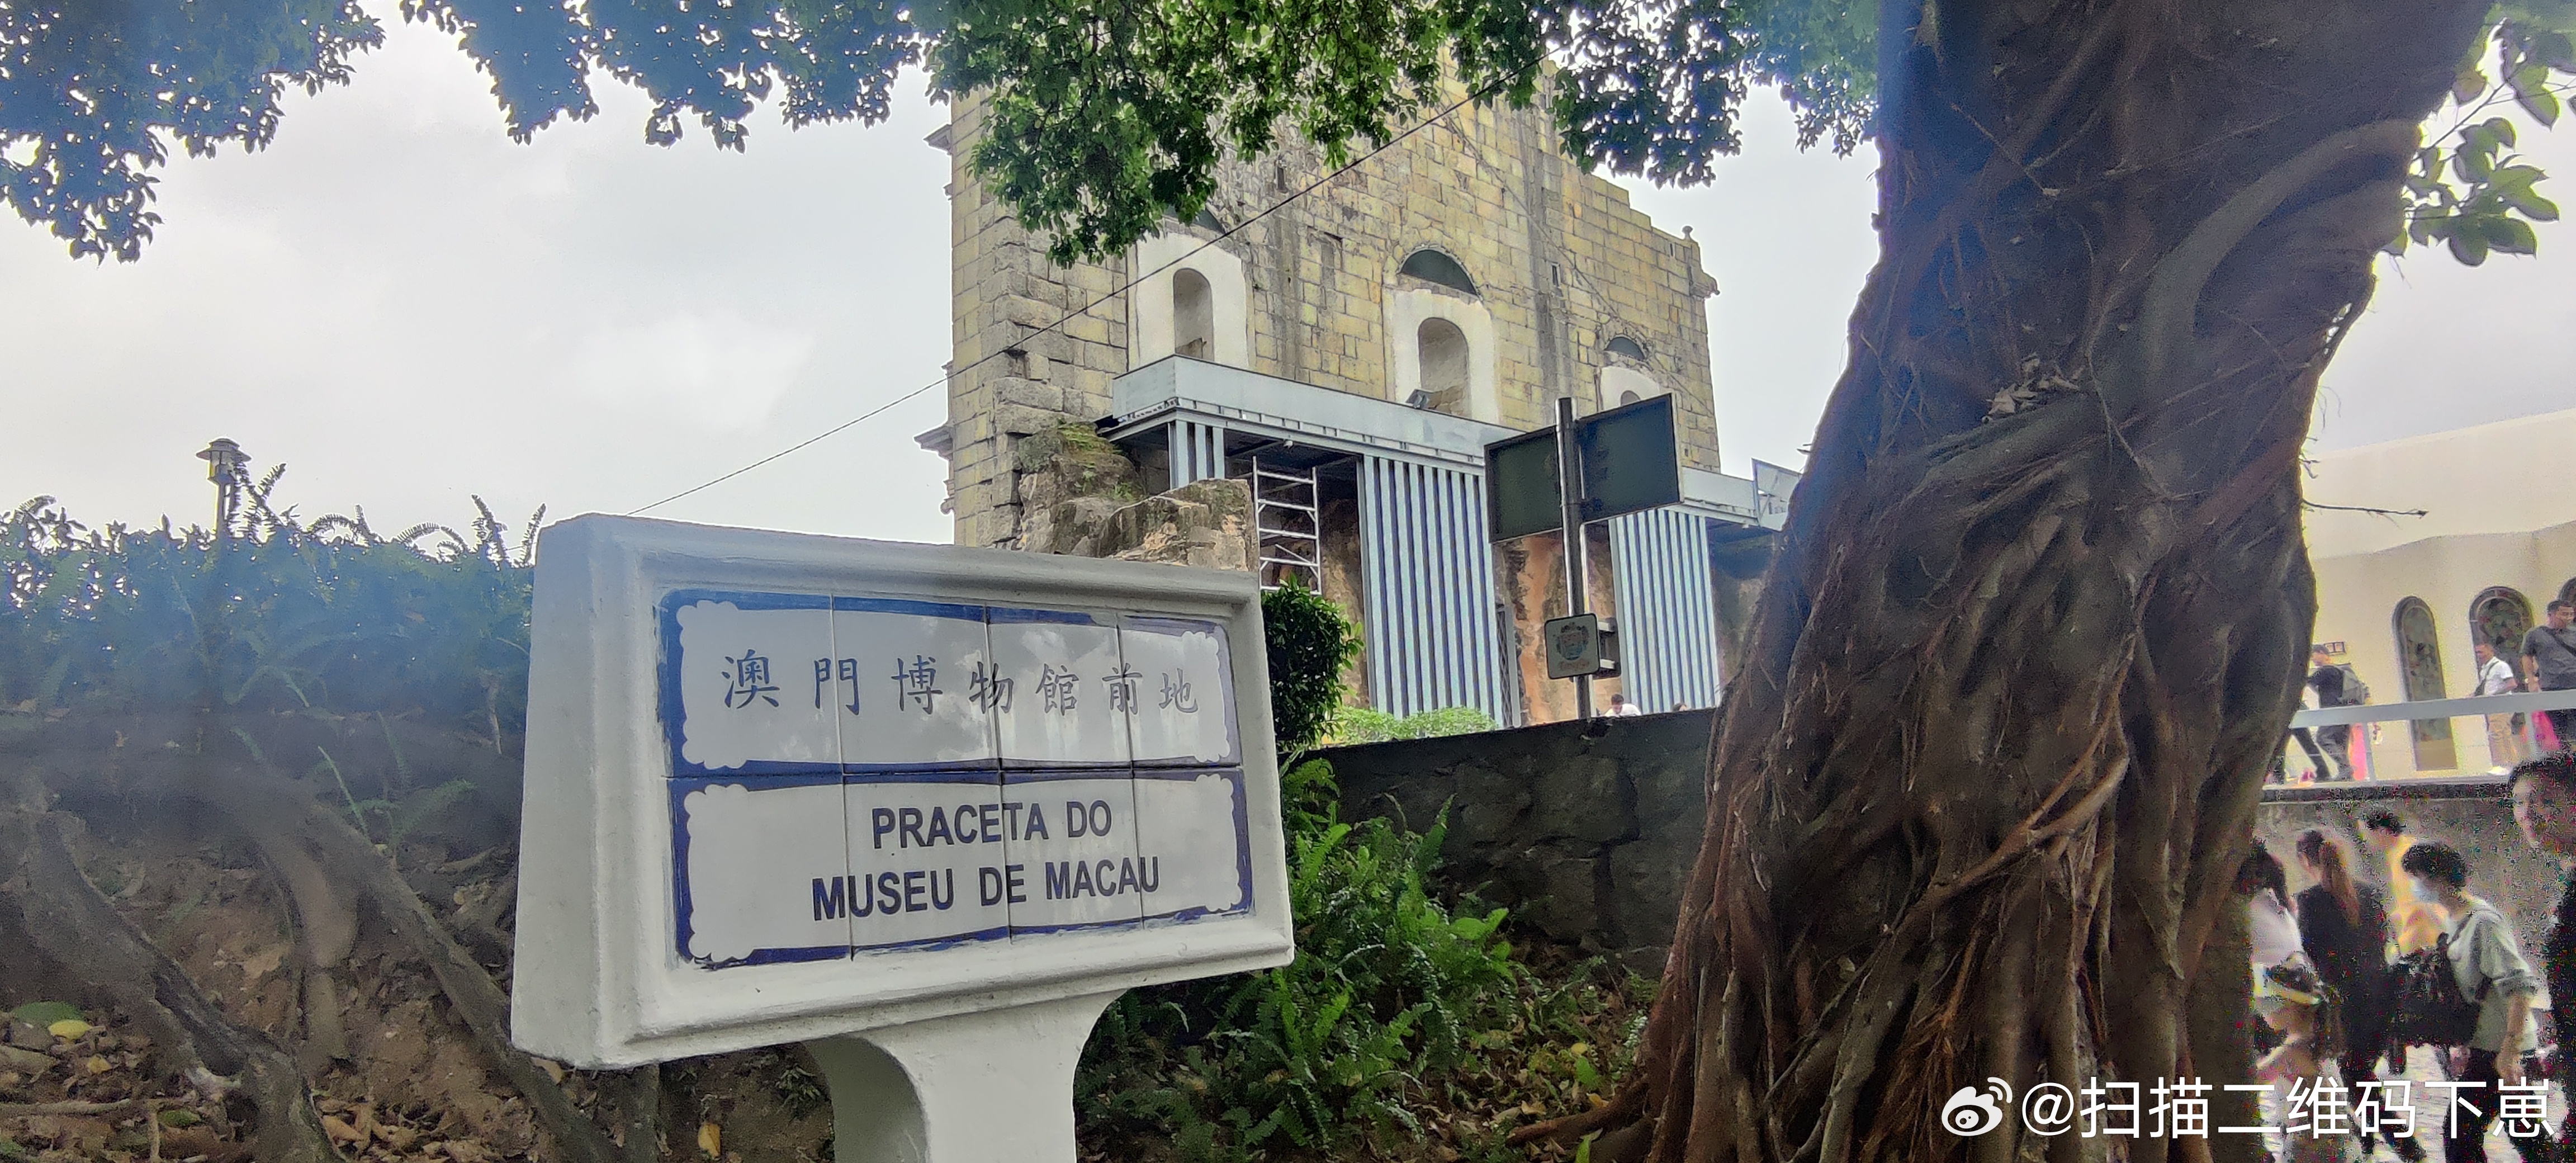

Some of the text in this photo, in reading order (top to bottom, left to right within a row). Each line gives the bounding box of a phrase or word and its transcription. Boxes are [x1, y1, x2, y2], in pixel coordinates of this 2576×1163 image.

[721, 649, 1199, 716] 澳門博物館前地
[872, 801, 1113, 849] PRACETA DO
[812, 856, 1161, 921] MUSEU DE MACAU
